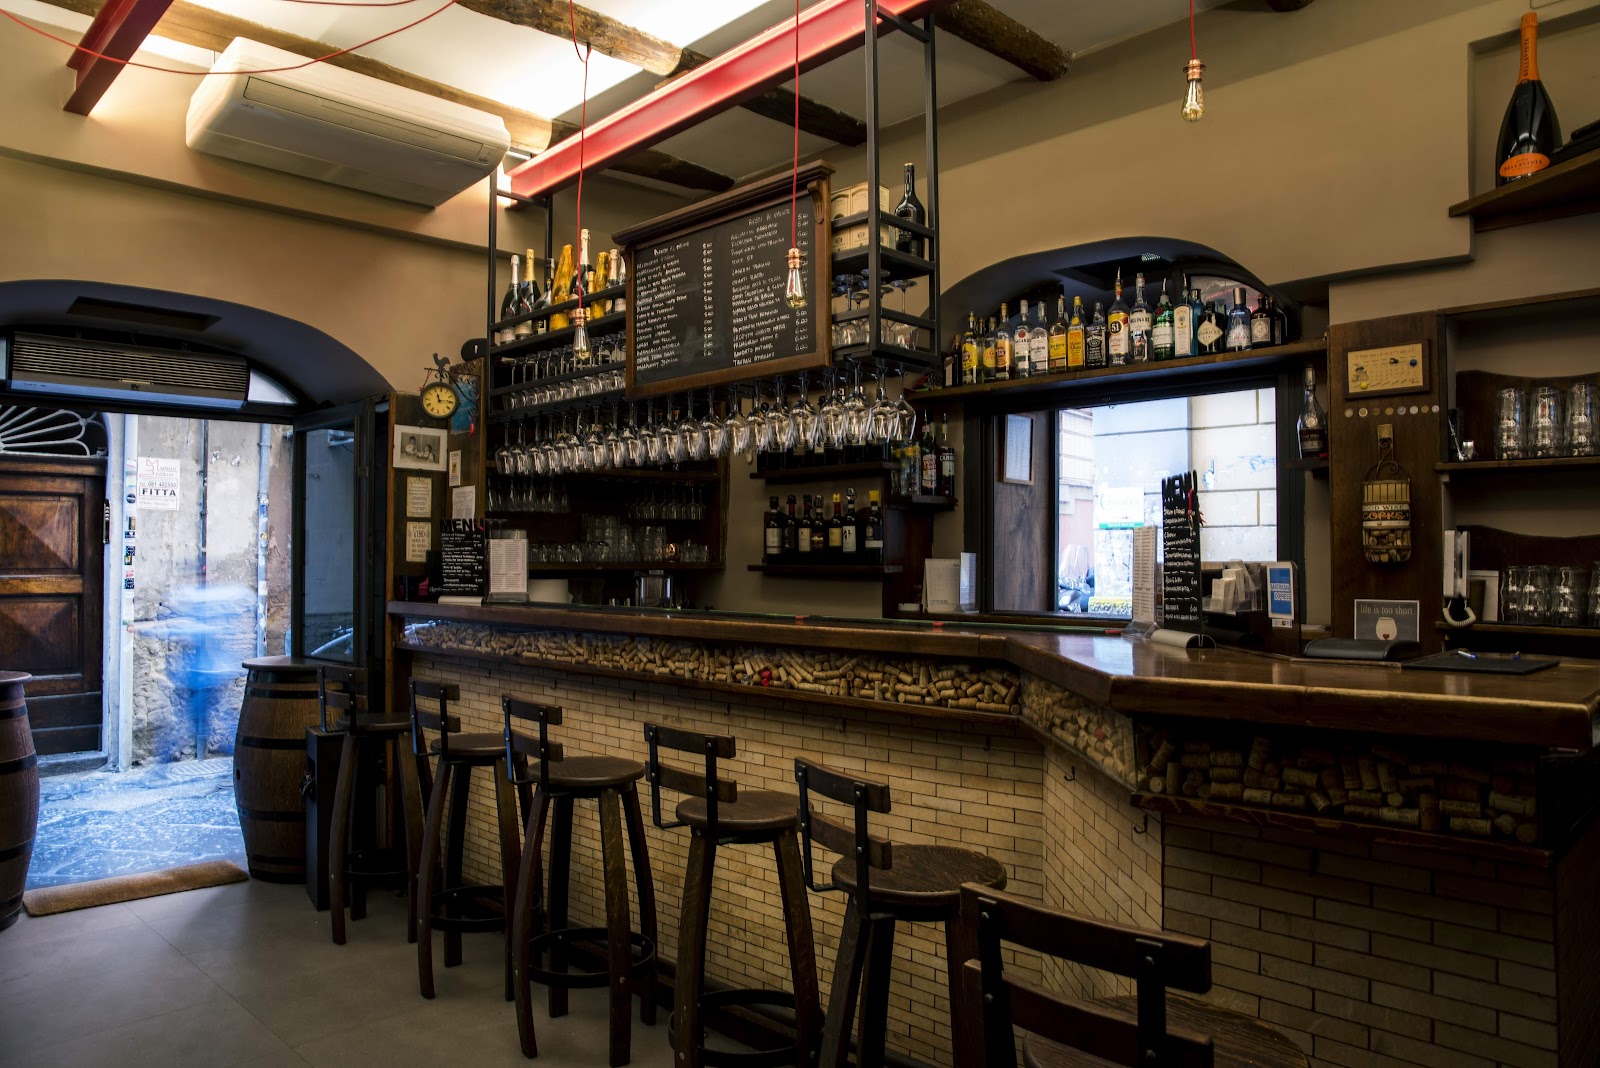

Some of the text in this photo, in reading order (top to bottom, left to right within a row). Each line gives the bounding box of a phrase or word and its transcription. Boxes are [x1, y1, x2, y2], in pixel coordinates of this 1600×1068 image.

[1503, 160, 1543, 171] BELLAVISTA
[1111, 323, 1120, 333] 51
[142, 488, 177, 497] FITTA
[1361, 605, 1413, 615] life is too short
